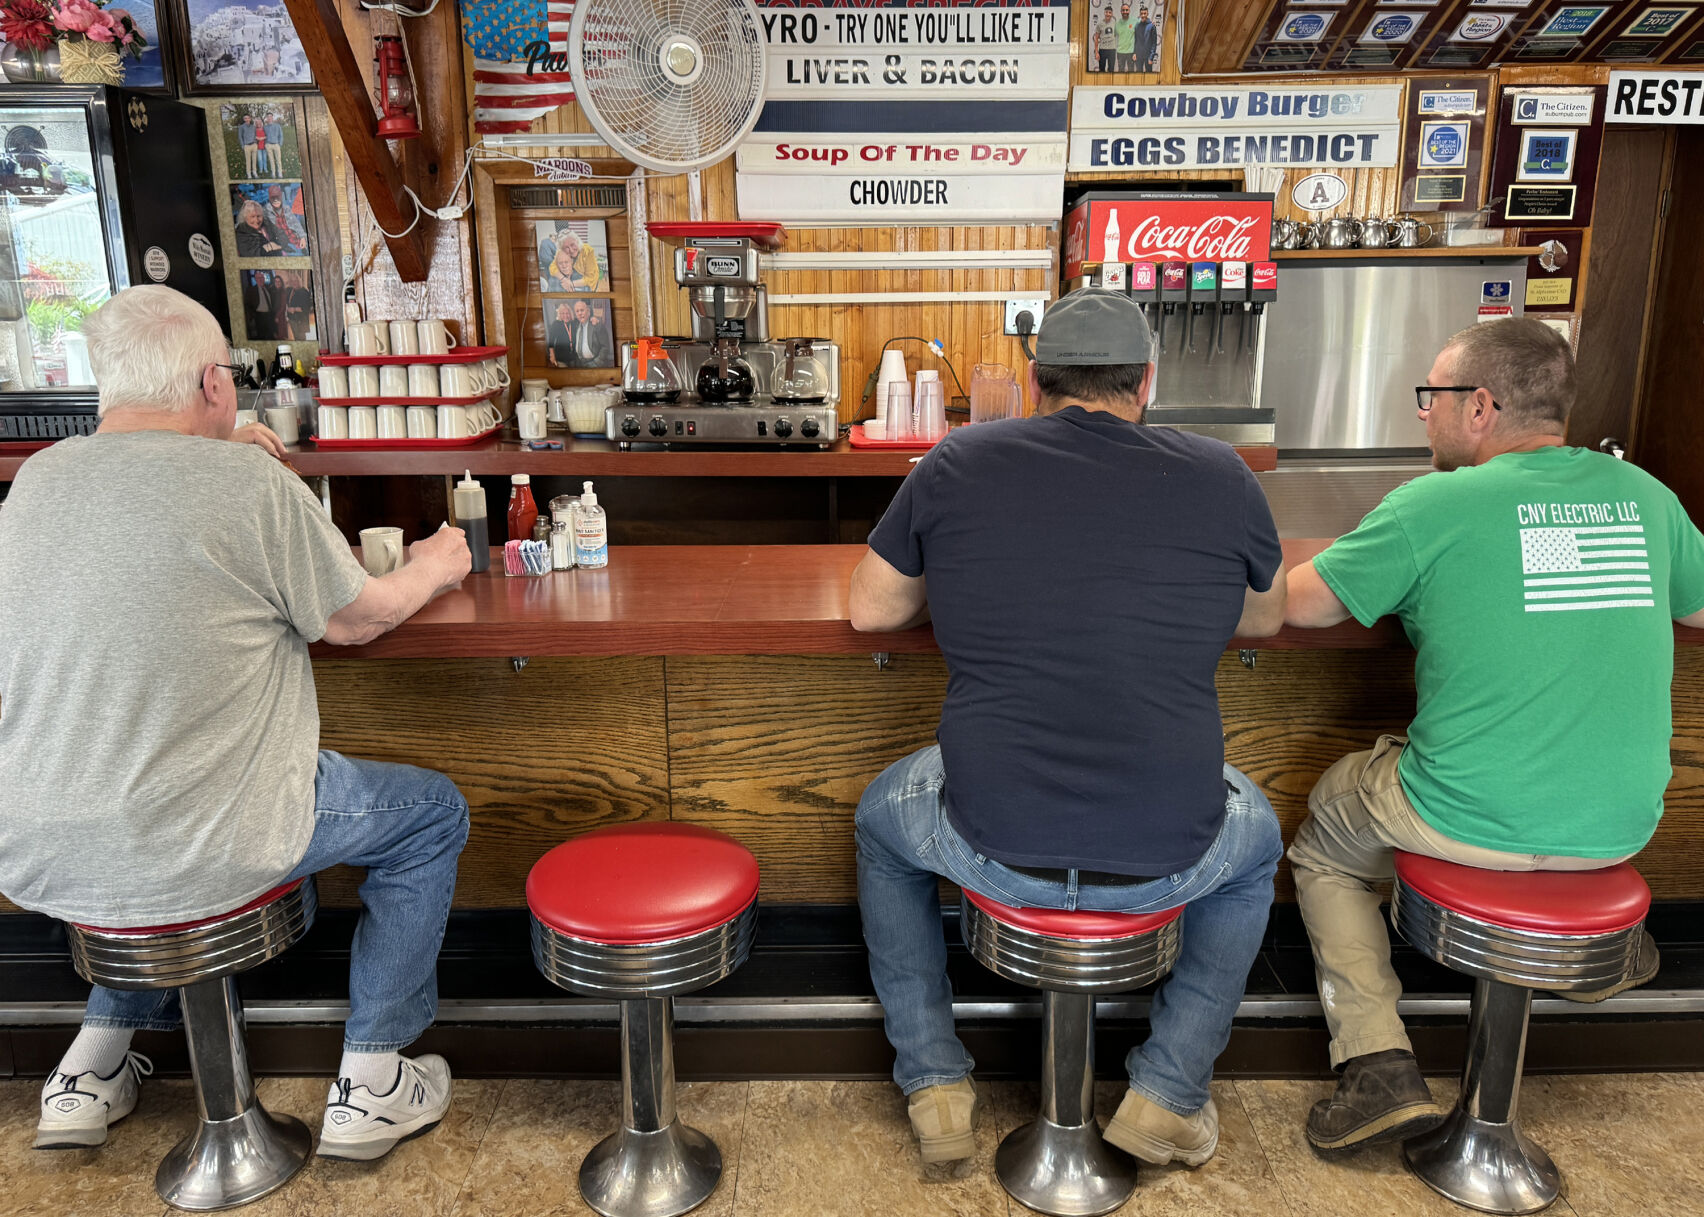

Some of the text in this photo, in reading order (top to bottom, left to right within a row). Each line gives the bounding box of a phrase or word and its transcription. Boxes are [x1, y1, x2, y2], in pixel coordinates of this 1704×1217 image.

[836, 13, 868, 44] TRY
[873, 13, 909, 44] ONE
[981, 13, 1021, 43] LIKE
[1027, 13, 1044, 43] IT
[787, 54, 1019, 85] LIVER & BACON
[1104, 91, 1367, 120] Cowboy Burger
[1541, 102, 1555, 110] The
[1614, 79, 1704, 116] REST
[775, 143, 1028, 166] Soup Of The Day
[1091, 133, 1380, 166] EGGS BENEDICT
[536, 159, 591, 176] MAROONS
[850, 179, 949, 205] CHOWDER
[1310, 182, 1330, 203] A
[1517, 501, 1640, 525] CNY ELECTRIC LLC
